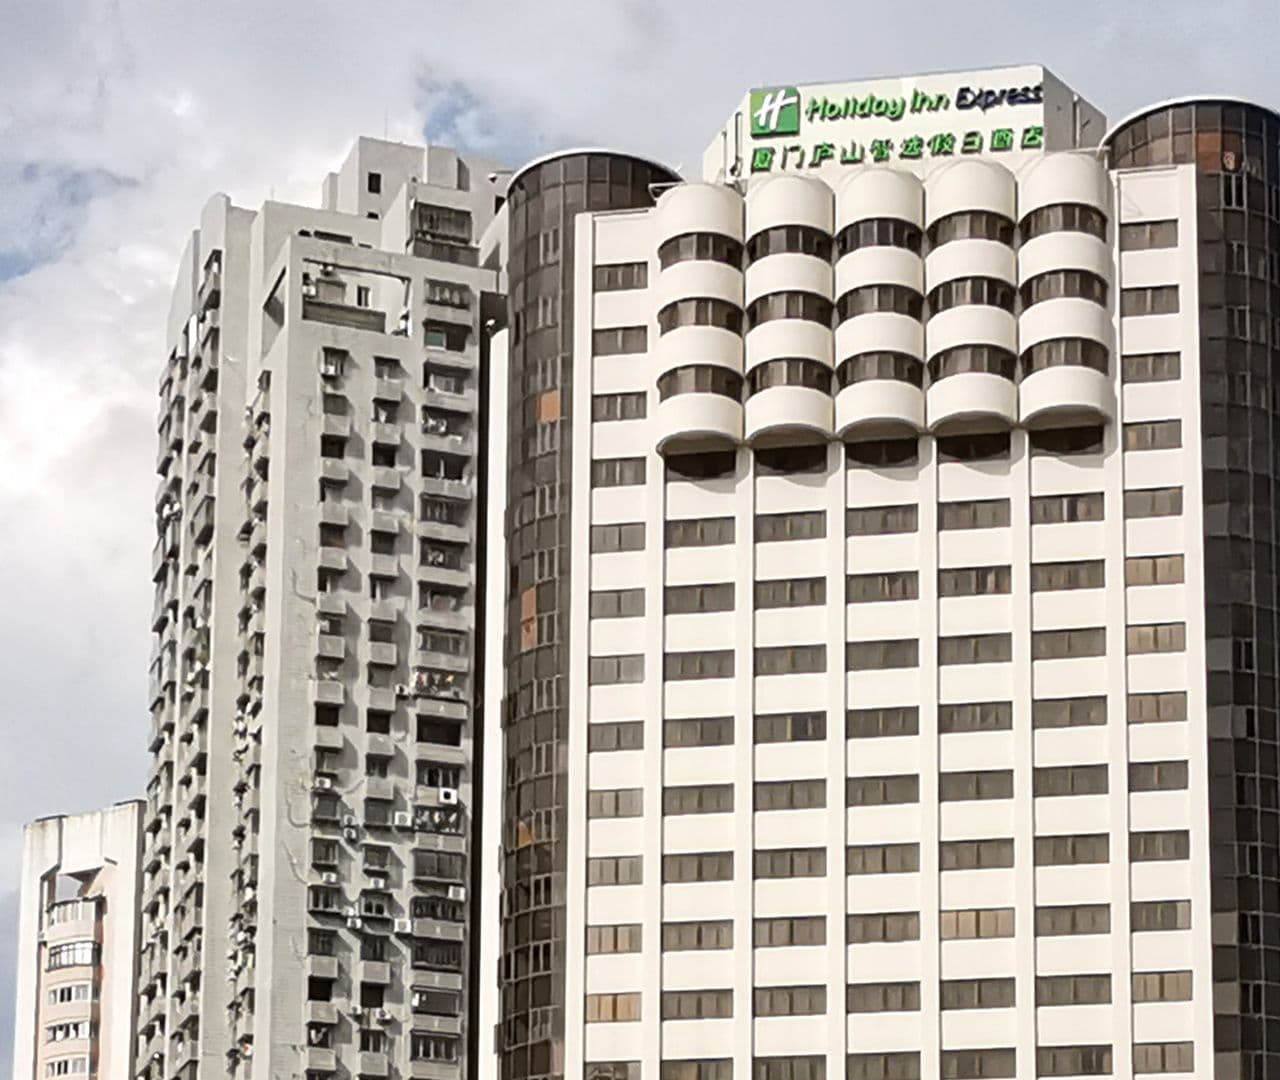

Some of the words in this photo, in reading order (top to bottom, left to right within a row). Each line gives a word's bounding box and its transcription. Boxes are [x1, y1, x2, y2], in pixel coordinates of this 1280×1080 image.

[806, 91, 906, 121] Holiday
[910, 88, 949, 114] Inn
[955, 85, 1043, 112] Express
[750, 127, 1043, 174] 厦门庐山智选假日酒店
